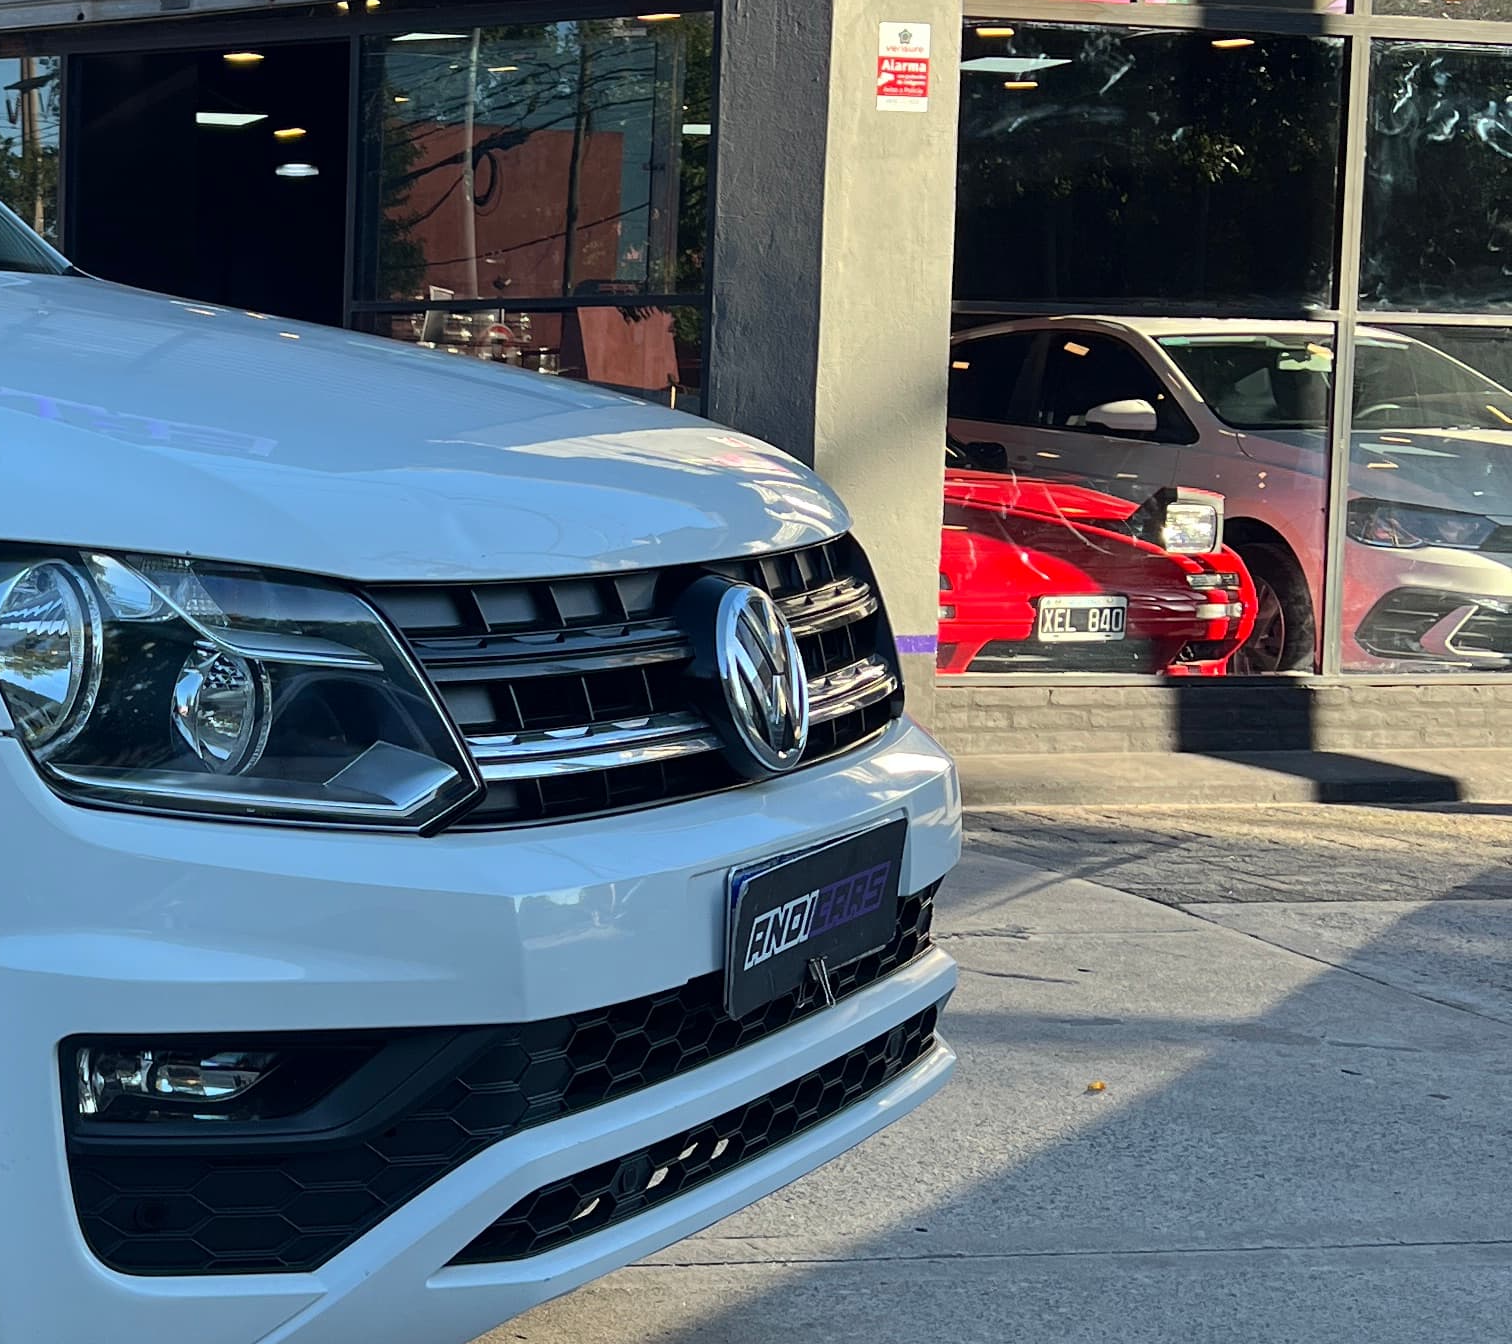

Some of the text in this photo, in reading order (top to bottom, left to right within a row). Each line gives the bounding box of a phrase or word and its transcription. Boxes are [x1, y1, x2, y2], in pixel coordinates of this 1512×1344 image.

[881, 59, 927, 73] Alarma
[1042, 608, 1123, 633] XEL 840
